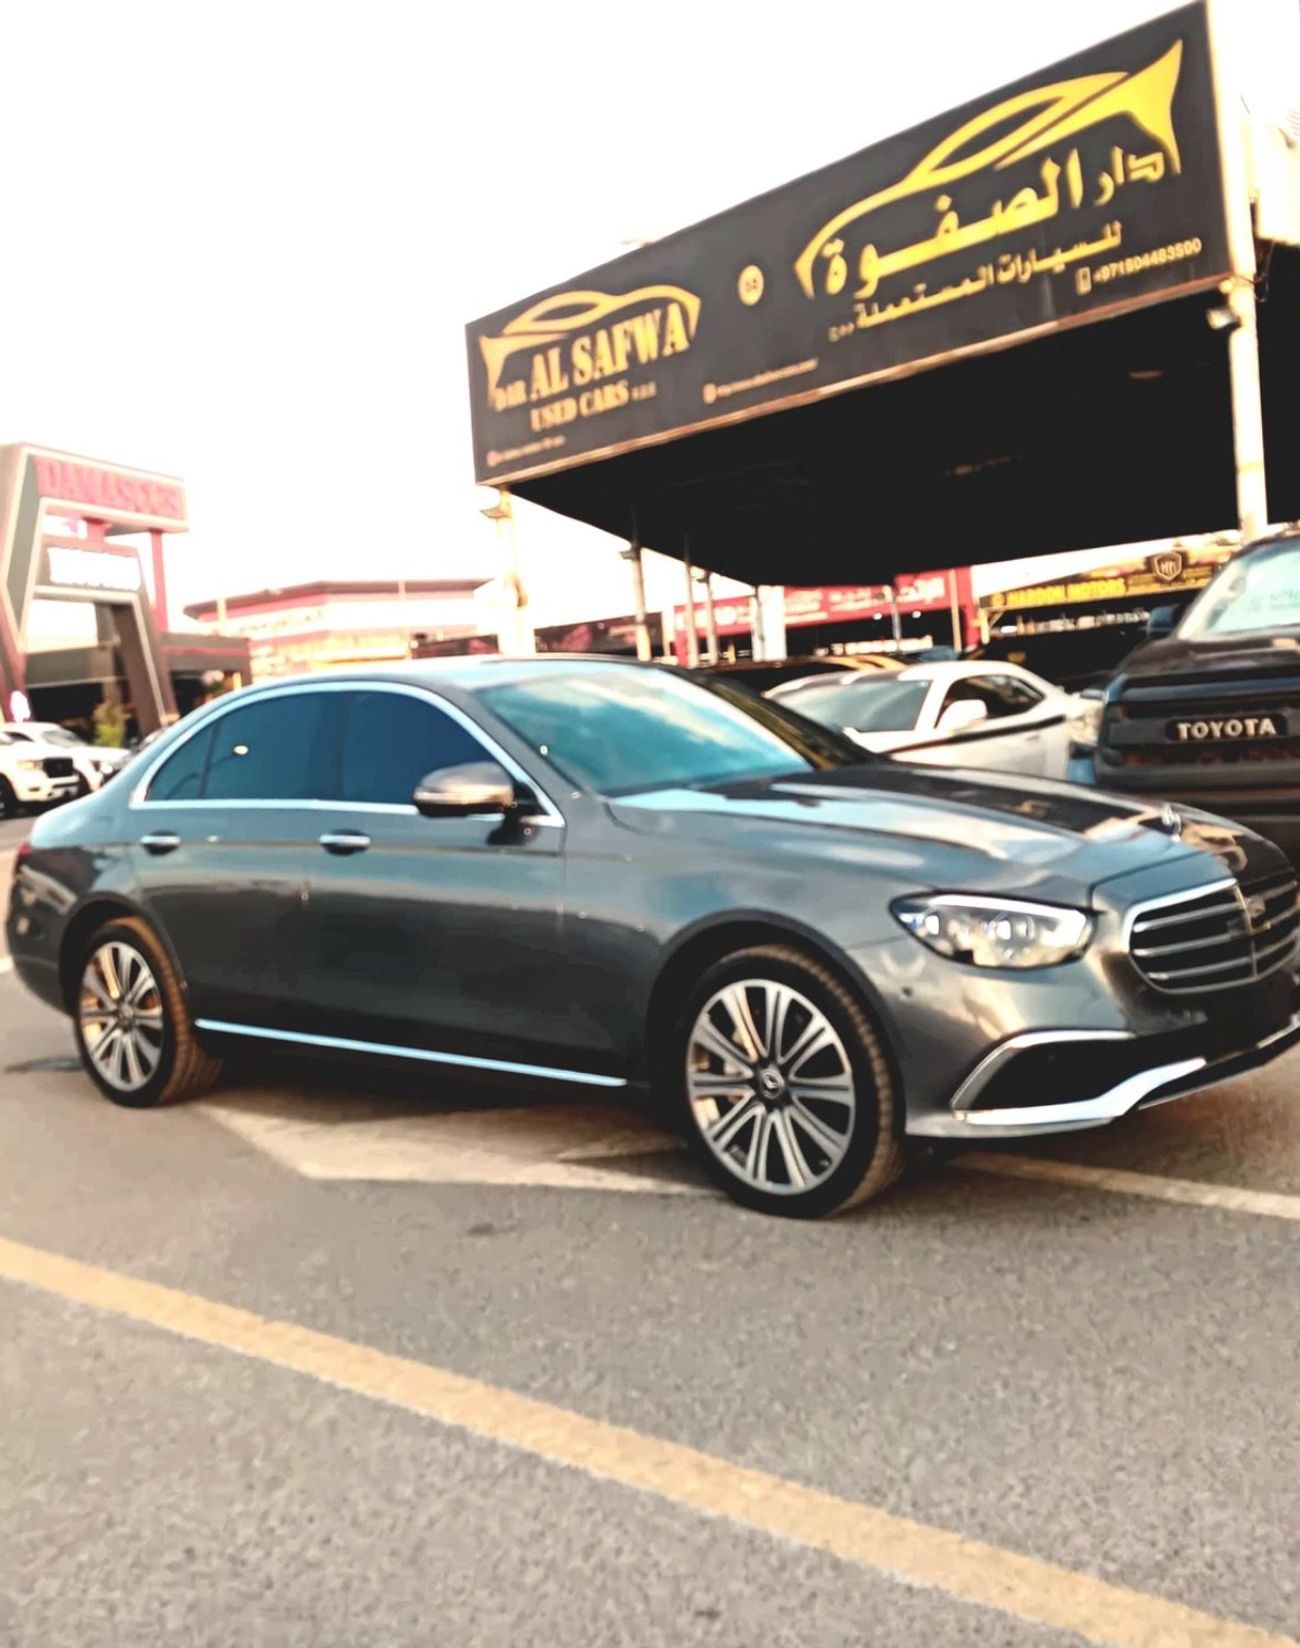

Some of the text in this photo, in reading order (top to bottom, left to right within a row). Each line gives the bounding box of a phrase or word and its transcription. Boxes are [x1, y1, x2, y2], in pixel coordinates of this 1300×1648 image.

[821, 145, 1165, 300] دار الصفوة
[530, 346, 569, 401] AL
[570, 302, 691, 386] SAFWA
[579, 378, 629, 417] CARS
[1178, 717, 1277, 740] TOYOTA
